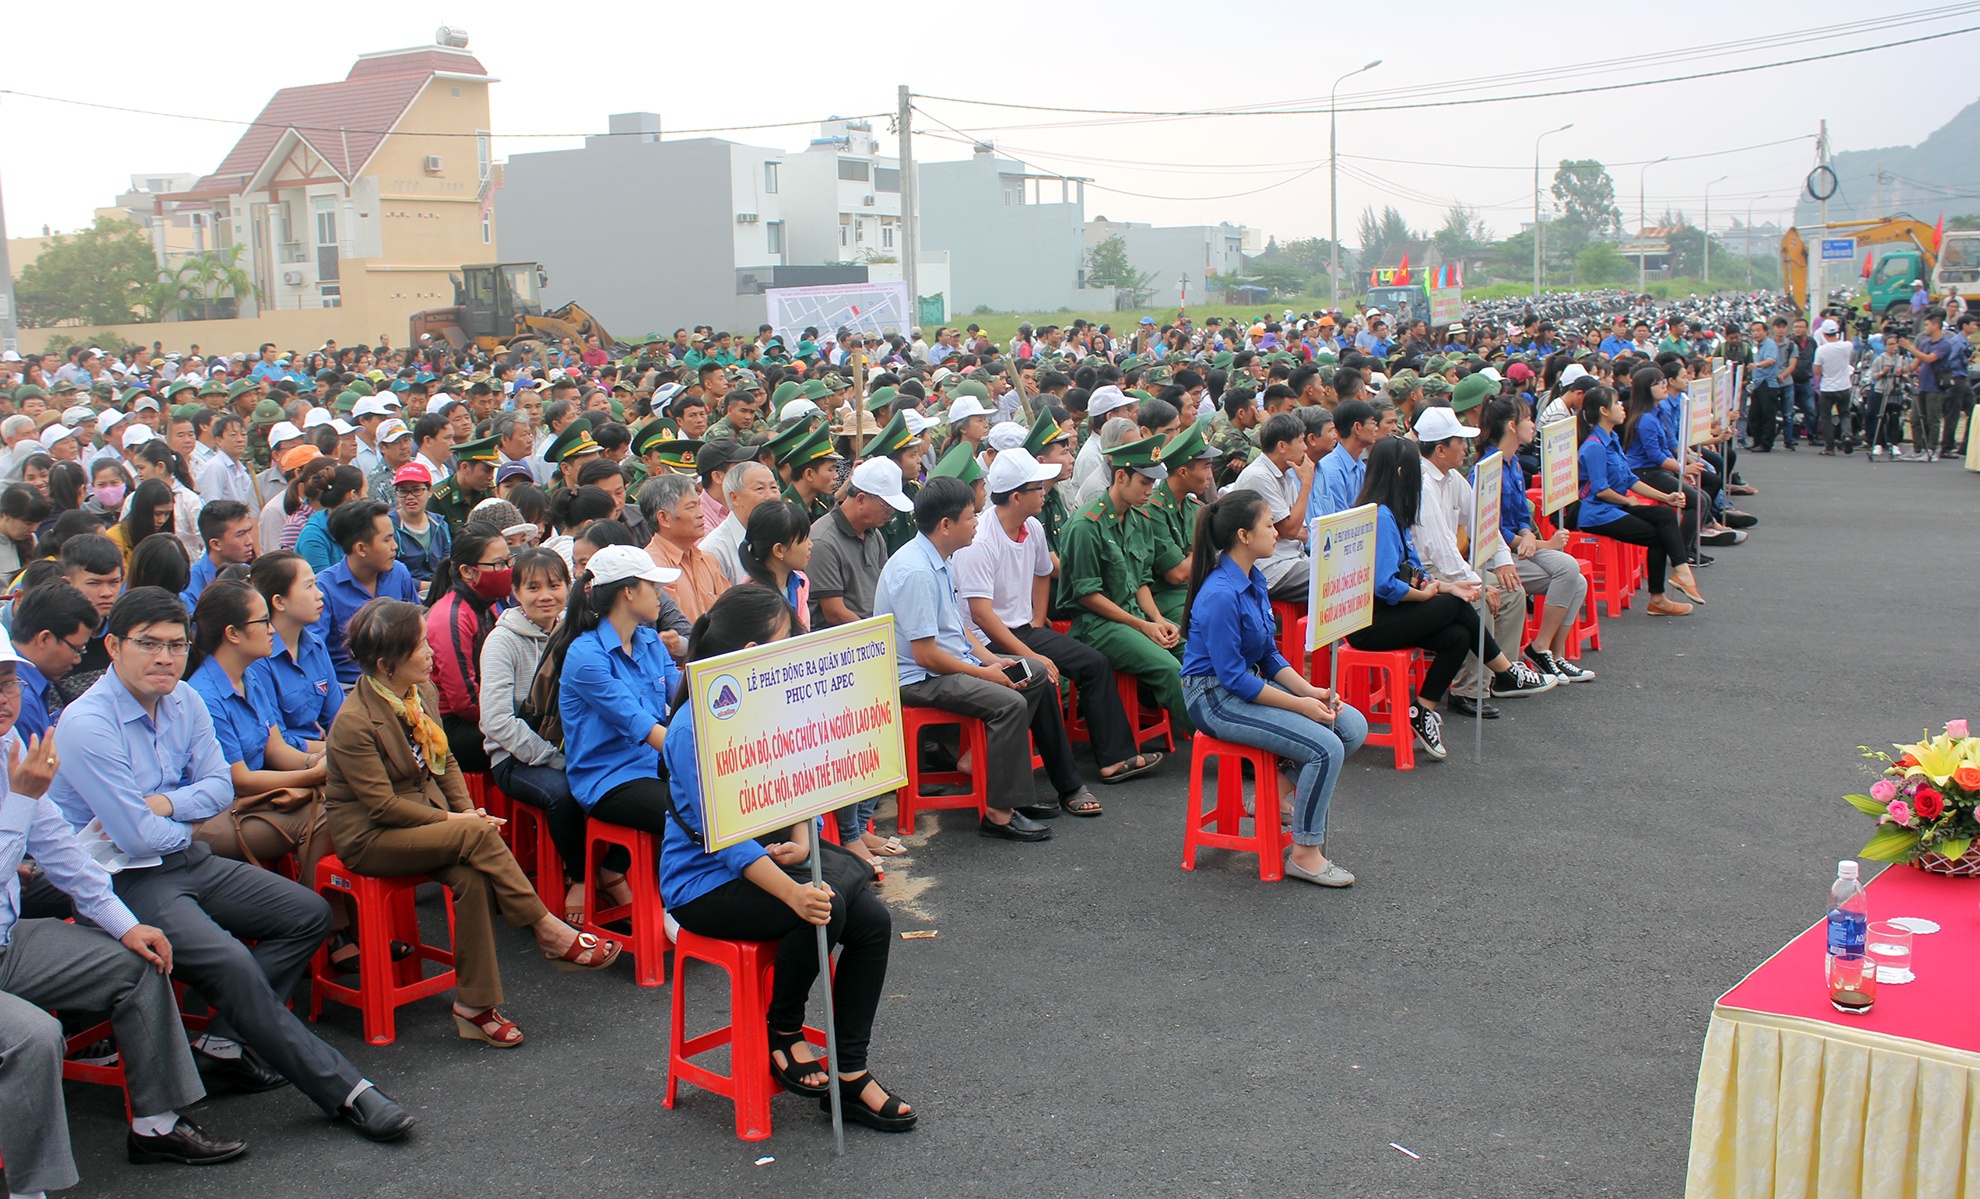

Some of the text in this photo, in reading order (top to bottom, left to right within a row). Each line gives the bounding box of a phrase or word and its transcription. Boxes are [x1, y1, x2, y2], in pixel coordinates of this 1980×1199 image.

[746, 640, 885, 692] LỄ PHÁT ĐỘNG RA QUÂN MÔI TRƯỜNG
[785, 671, 854, 704] PHỤC VỤ APEC
[715, 697, 891, 777] KHỐI CÁN BỘ, CÔNG CHỨC VÀ NGƯỜI LAO ĐỘNG
[739, 741, 880, 814] CỦA CÁC HỘI, ĐOÀN THỂ THUỘC QUẬN
